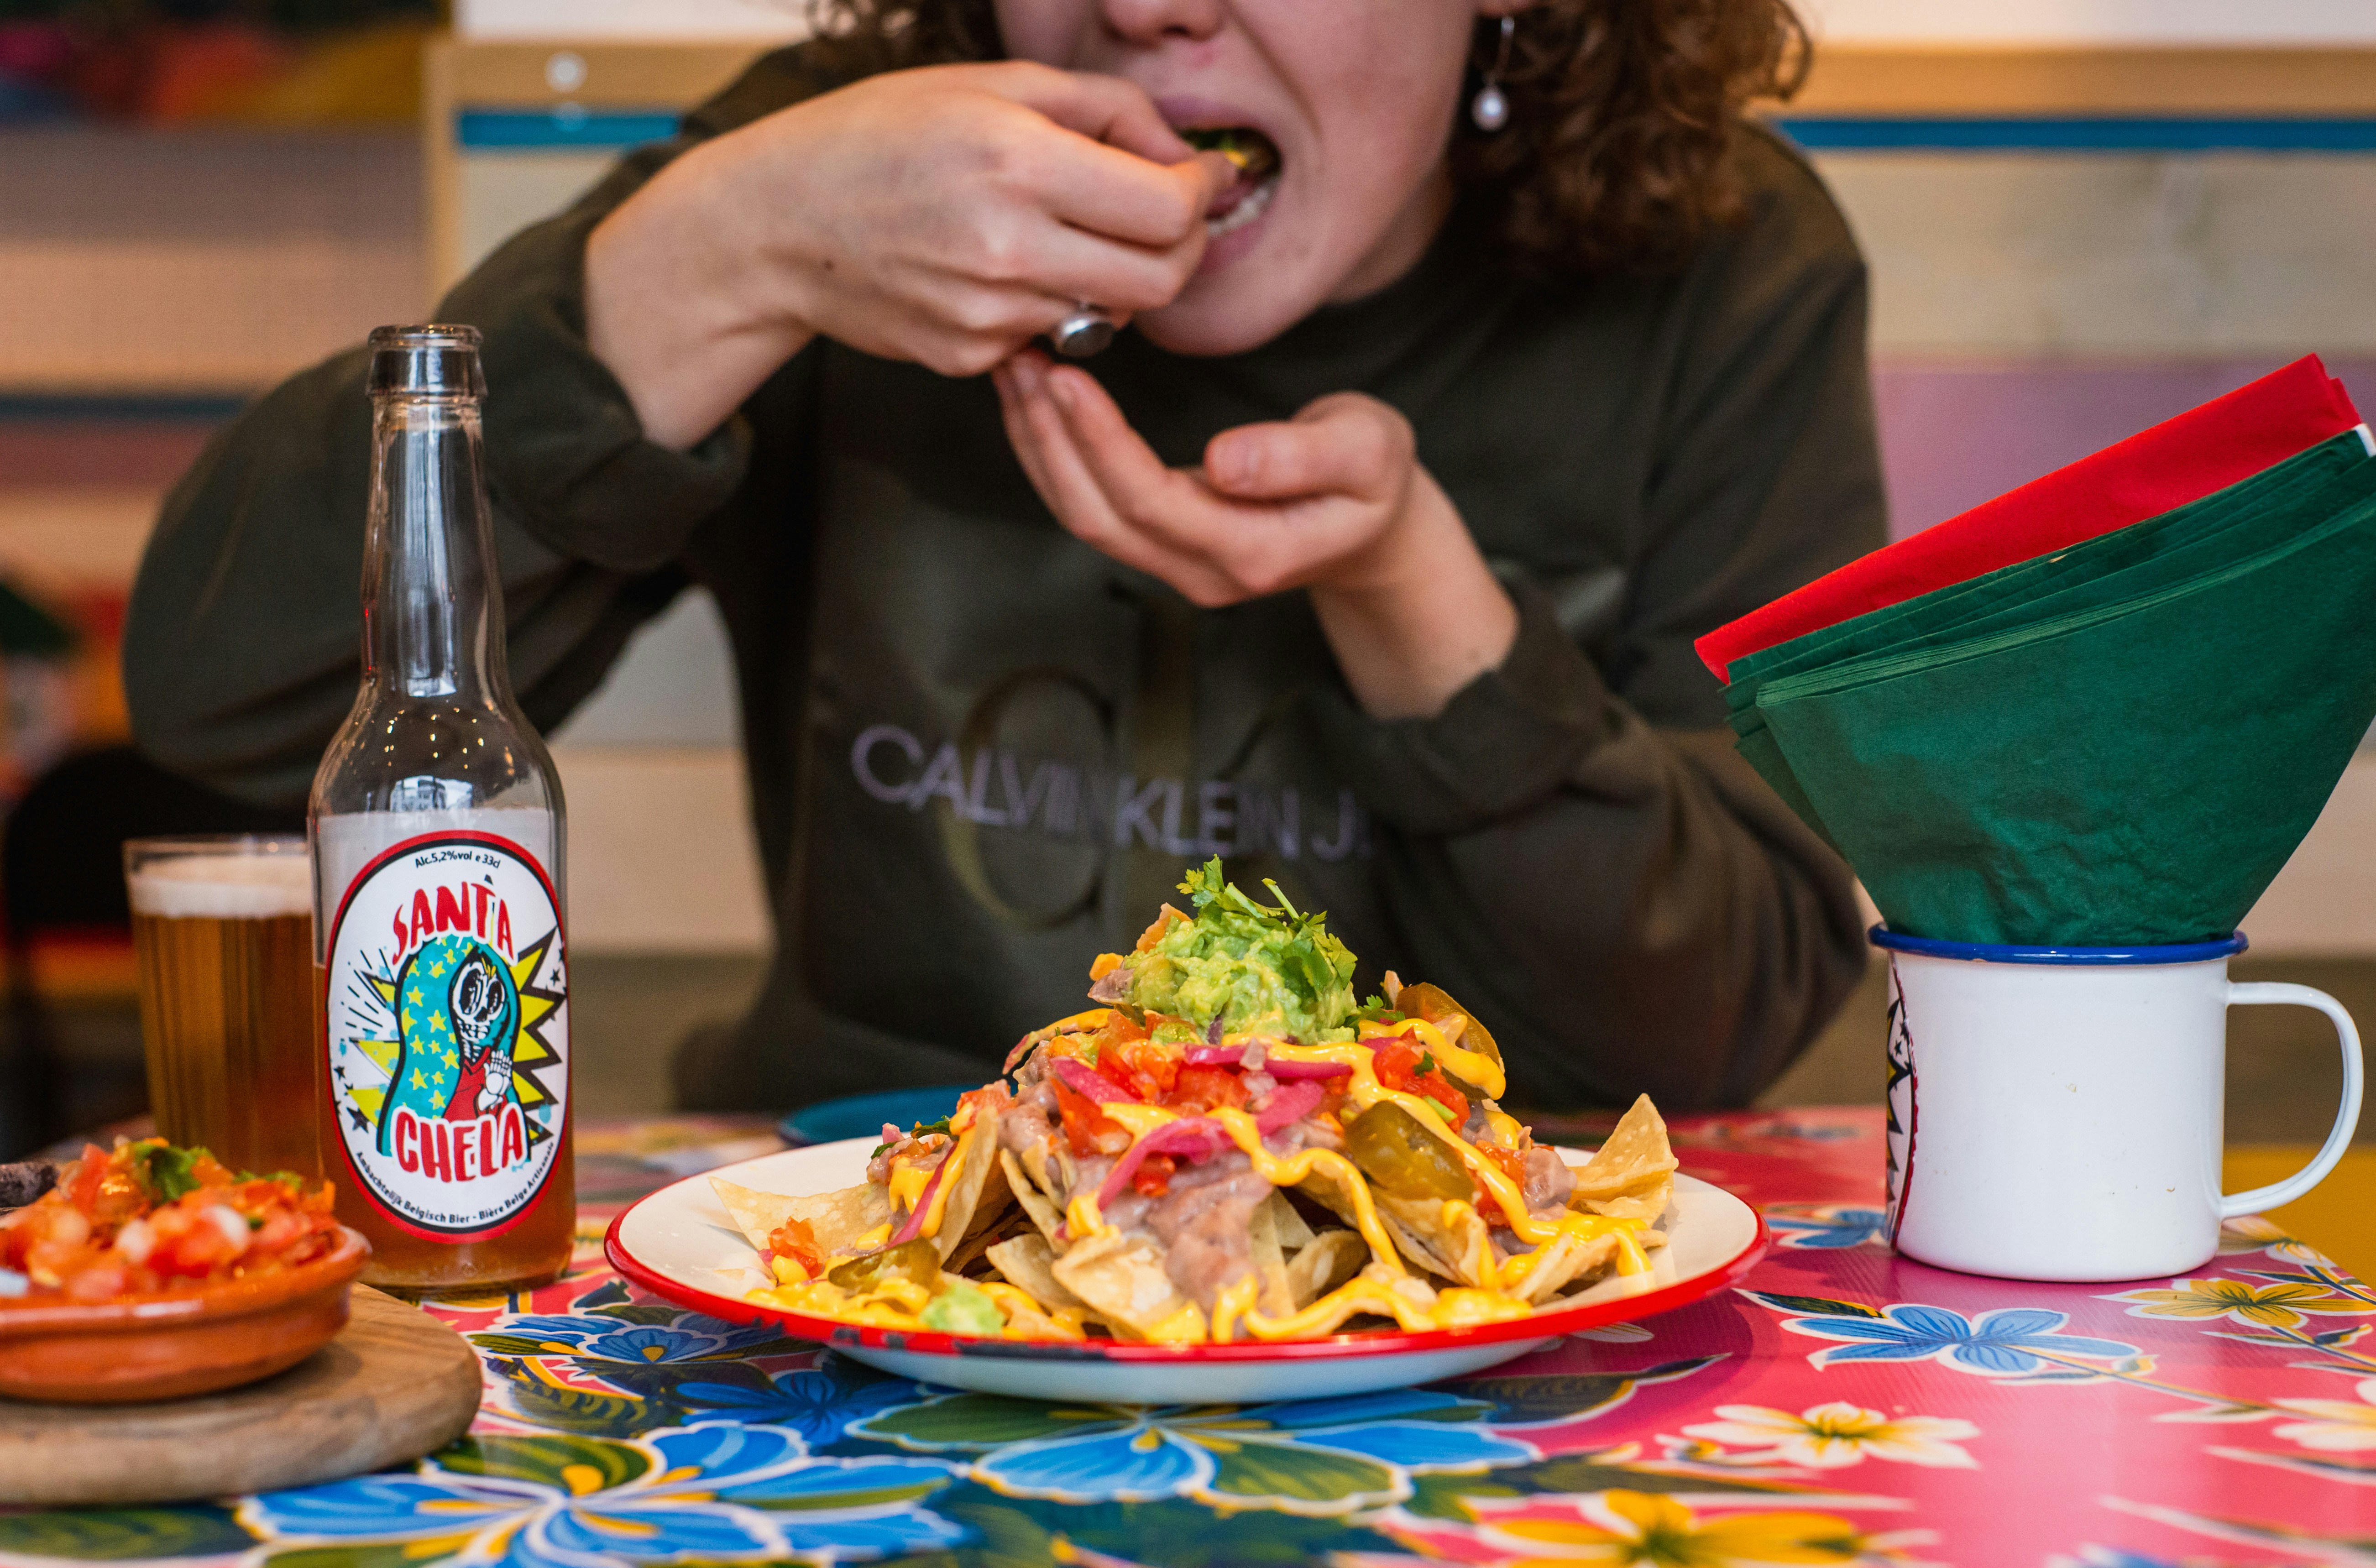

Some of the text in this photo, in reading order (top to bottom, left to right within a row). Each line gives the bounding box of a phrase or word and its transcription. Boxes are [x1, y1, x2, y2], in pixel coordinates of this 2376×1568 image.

[393, 881, 515, 966] SANTA
[395, 1108, 523, 1183] CHELA
[356, 1151, 402, 1206] Ambachtelijk
[403, 1200, 446, 1223] Belgisch
[449, 1214, 470, 1223] Bier
[478, 1205, 504, 1220] Bière
[504, 1187, 528, 1209] Belge
